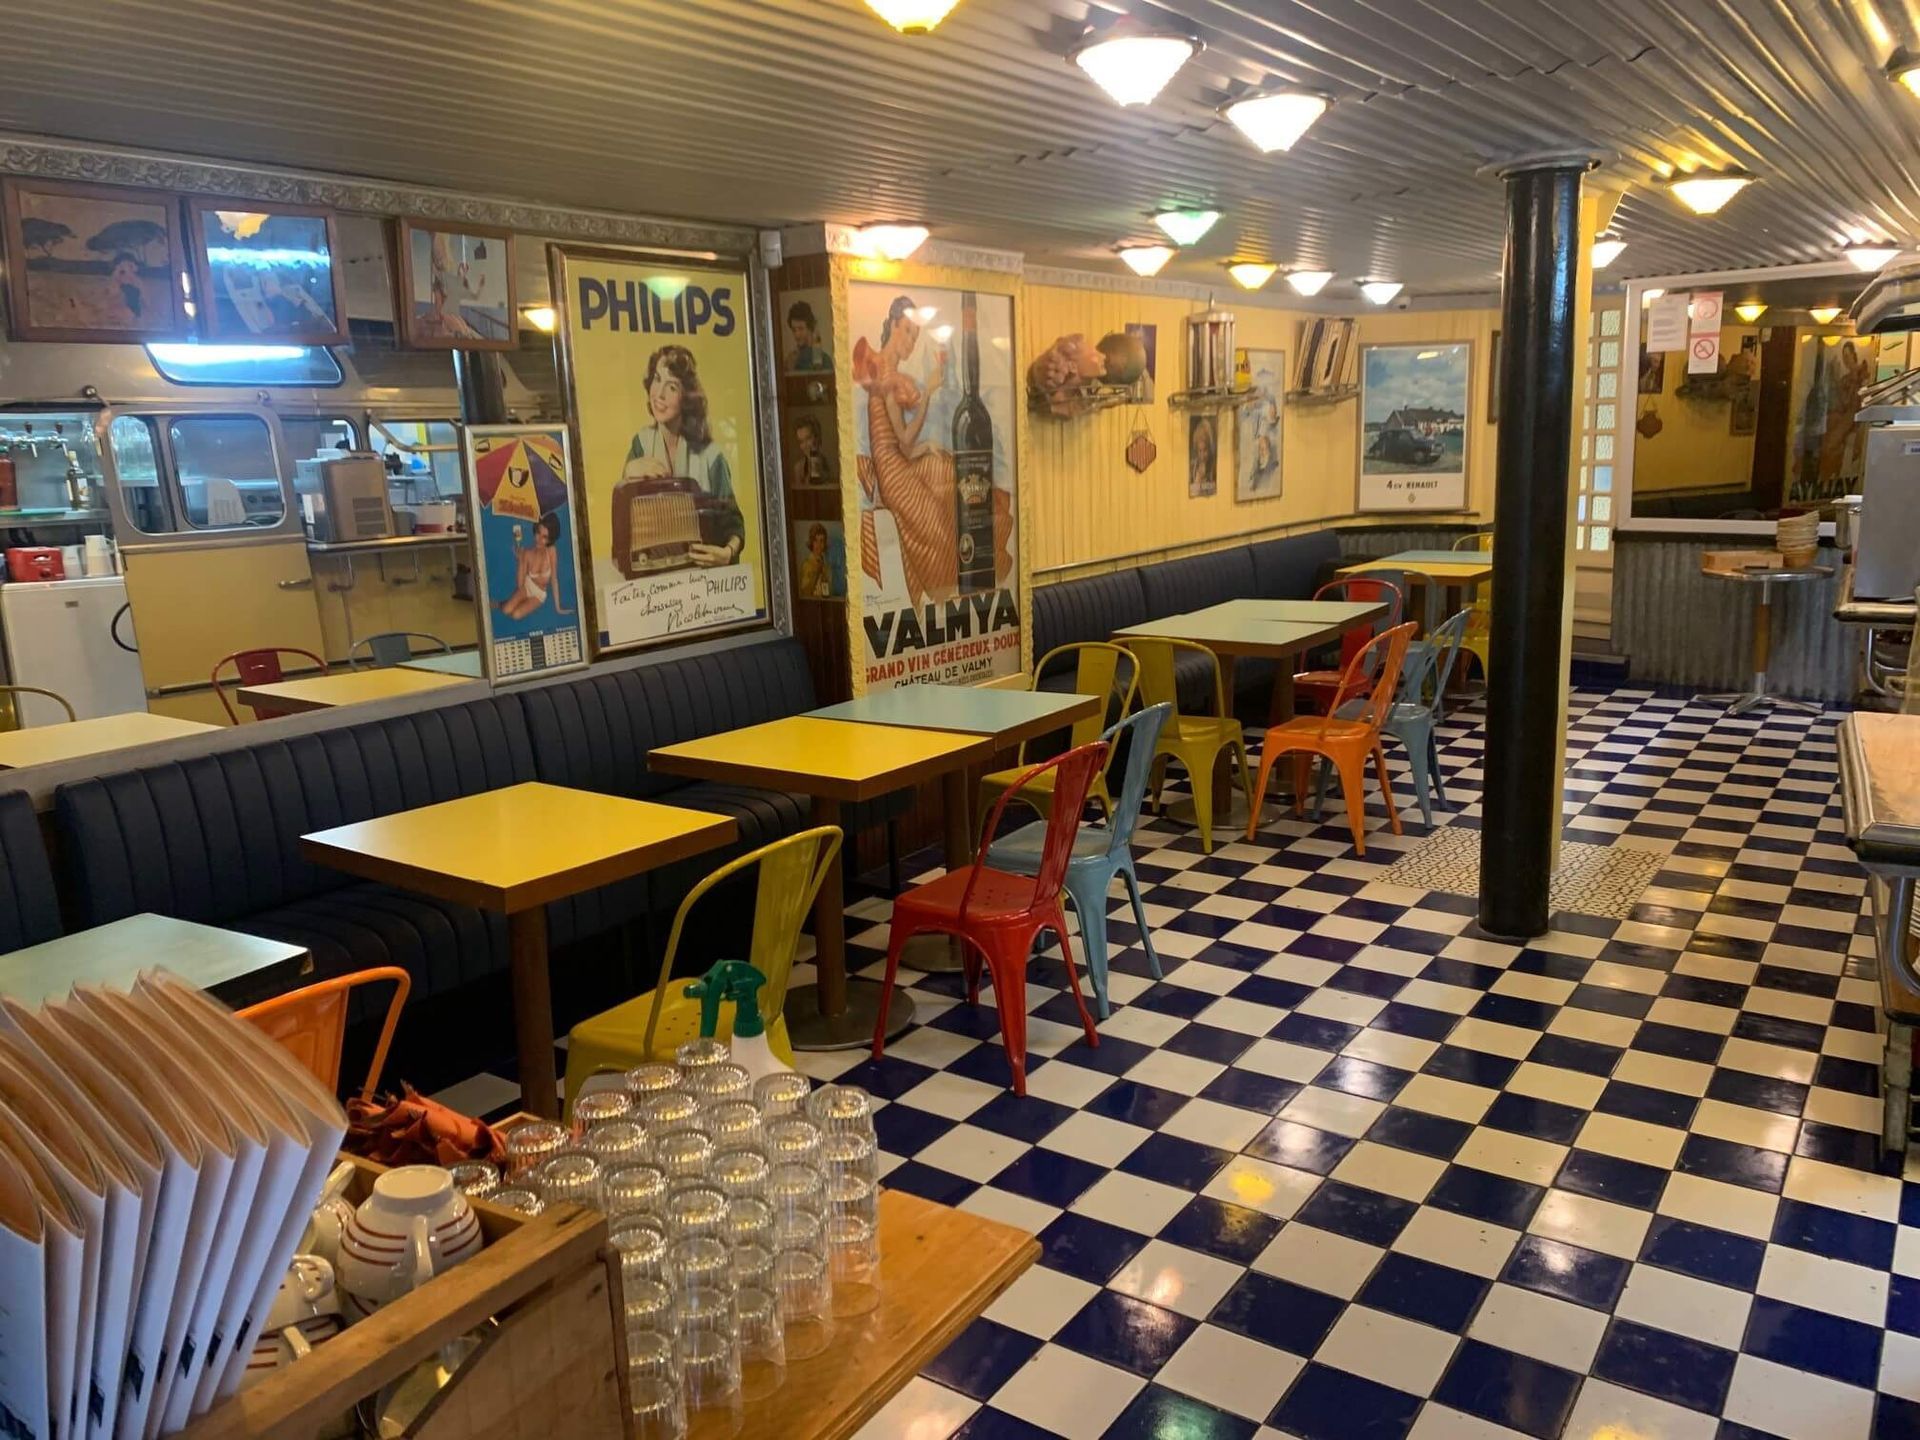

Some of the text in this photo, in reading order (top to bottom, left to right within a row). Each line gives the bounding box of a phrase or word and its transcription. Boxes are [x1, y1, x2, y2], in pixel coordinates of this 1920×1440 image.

[578, 277, 735, 337] PHILIPS
[1406, 481, 1438, 489] RENAULT
[706, 575, 748, 597] PHILIPS
[863, 588, 1020, 659] VALMYA
[908, 654, 930, 672] VIN
[934, 638, 990, 667] GÉNÉREUX
[994, 631, 1020, 651] DOUX
[945, 666, 959, 679] DE
[962, 656, 993, 674] VALMY
